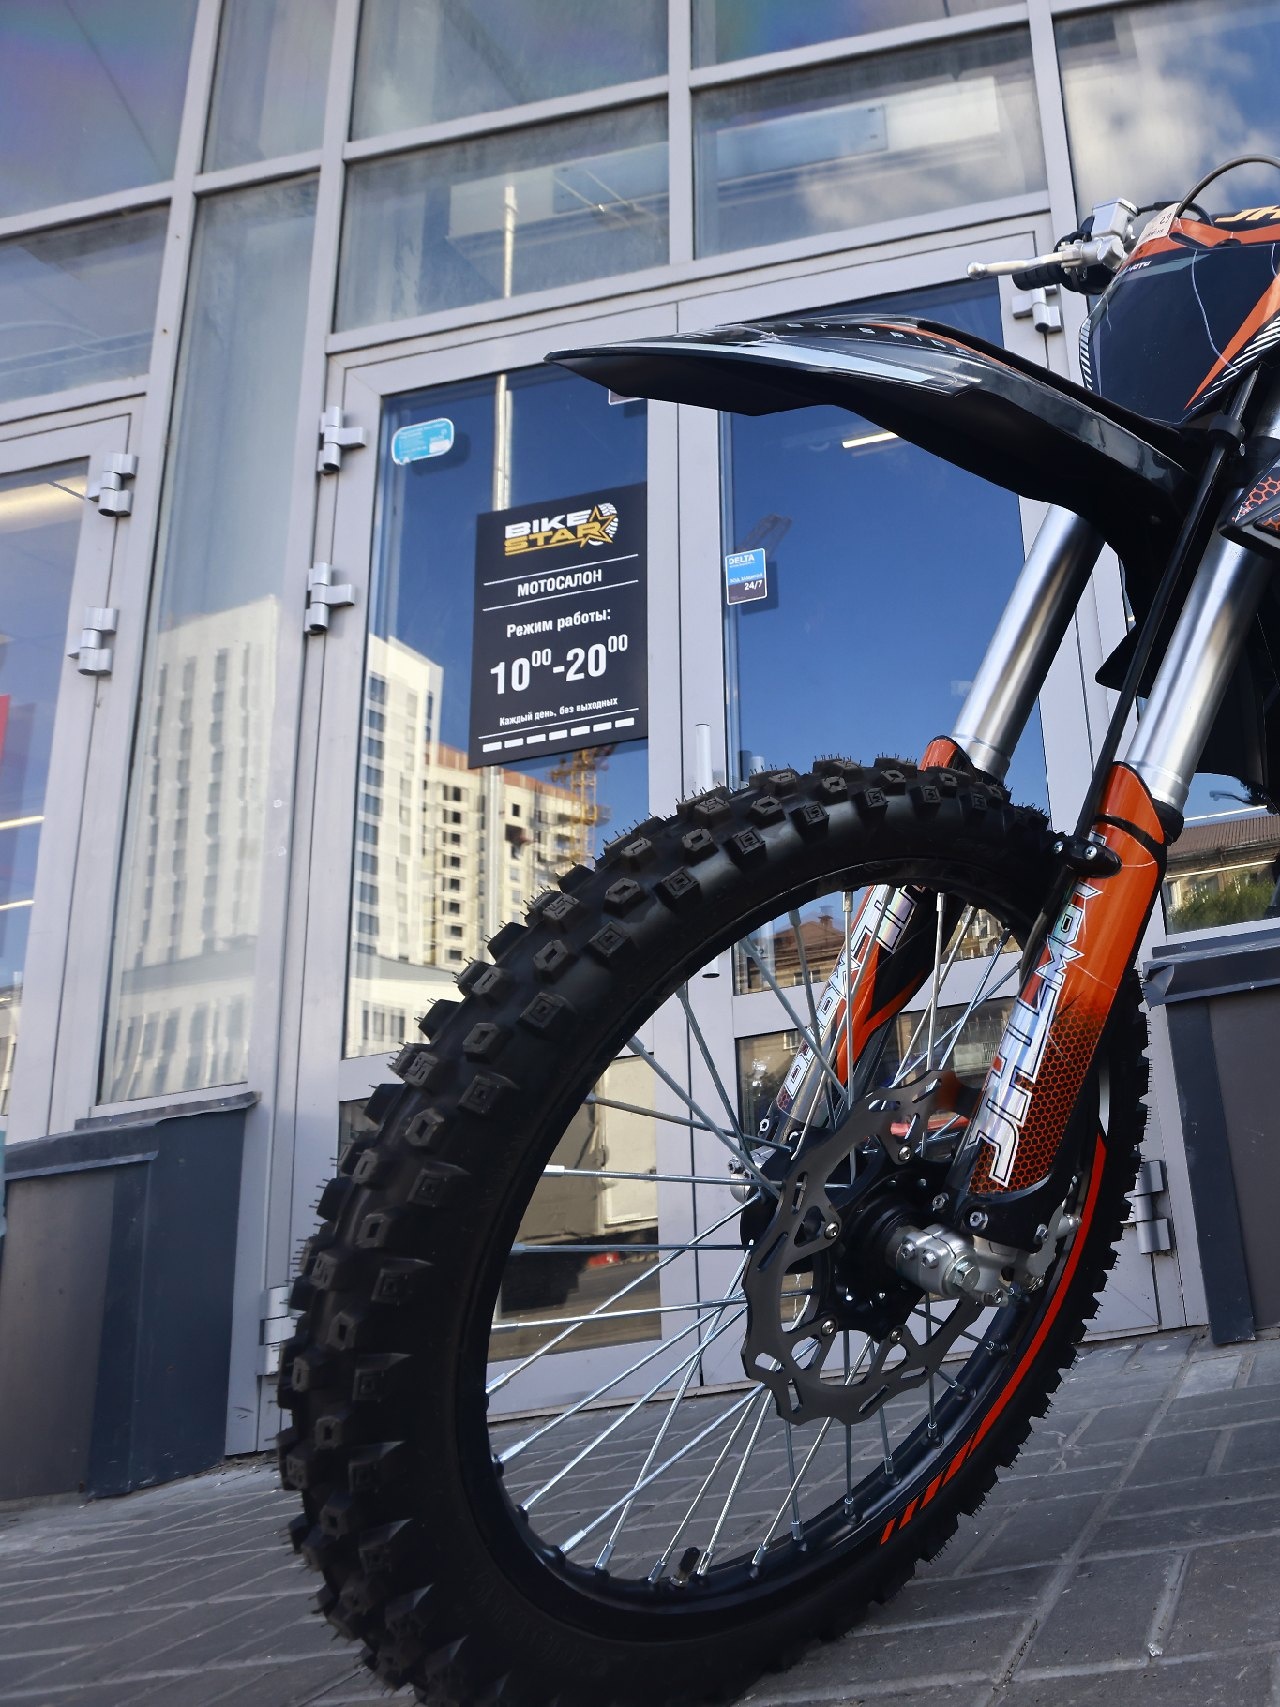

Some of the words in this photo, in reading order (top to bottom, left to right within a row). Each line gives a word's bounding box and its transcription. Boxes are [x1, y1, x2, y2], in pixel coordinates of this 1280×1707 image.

[504, 521, 604, 553] STAR
[505, 509, 592, 539] BIKE
[729, 554, 755, 565] DELTA
[517, 569, 602, 597] МОТОСАЛОН
[744, 579, 763, 590] 24/7
[506, 620, 553, 638] Режим
[557, 608, 611, 632] работы:
[499, 711, 533, 727] Каждый
[534, 709, 557, 722] день,
[559, 705, 575, 715] без
[576, 697, 618, 712] выходных
[969, 984, 1063, 1188] JHL
